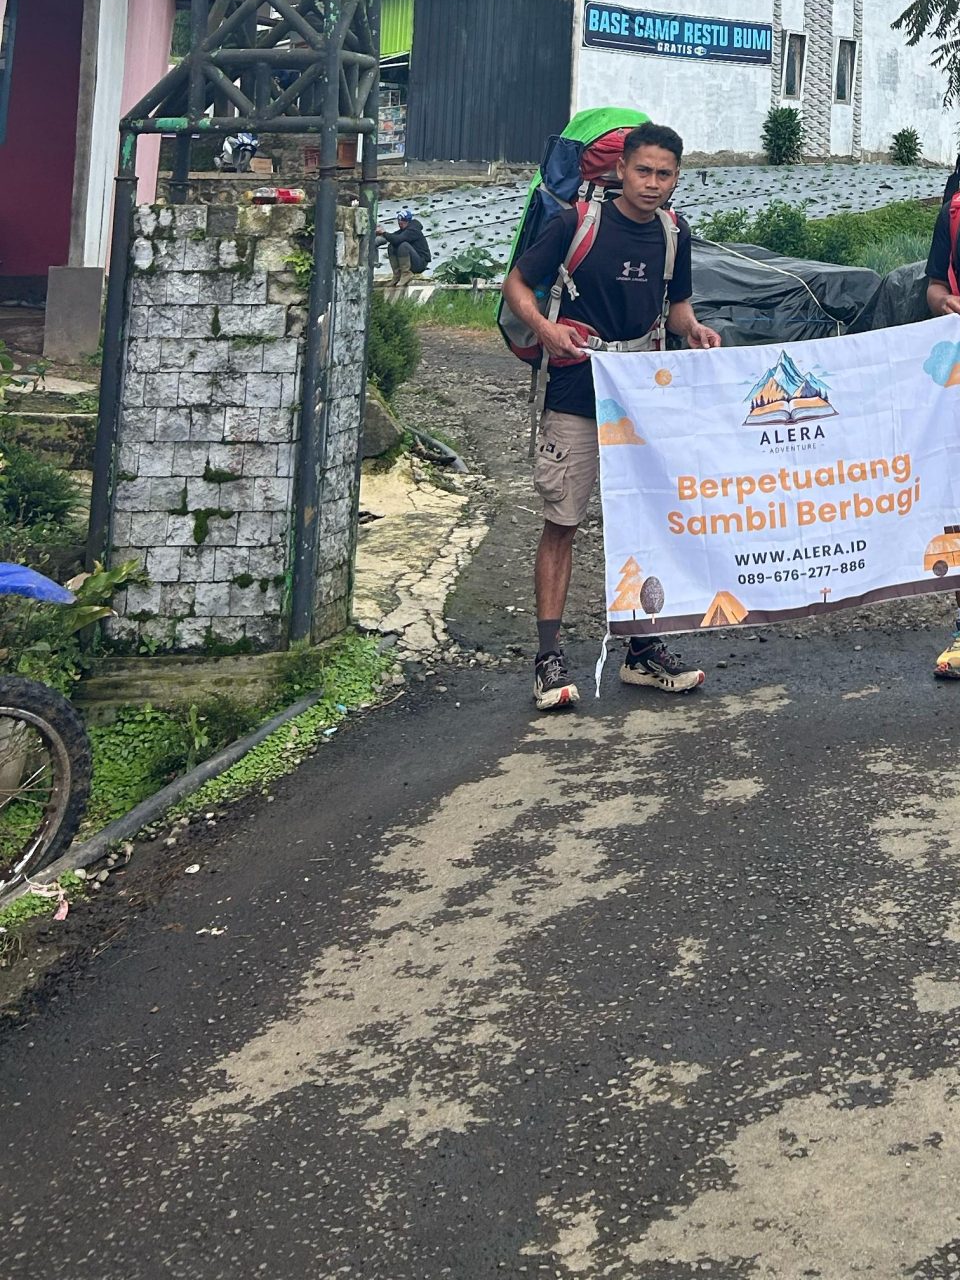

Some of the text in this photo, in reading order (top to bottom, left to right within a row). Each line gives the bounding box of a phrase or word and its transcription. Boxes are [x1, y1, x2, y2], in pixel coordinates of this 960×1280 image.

[589, 8, 771, 51] BASE CAMP RESTU BUMI
[657, 42, 693, 55] GRATIS
[760, 425, 825, 445] ALERA
[769, 443, 816, 454] ADVENTURE
[678, 452, 912, 504] Berpetualang
[668, 477, 921, 536] Sambil Berbagi
[735, 539, 867, 566] WWW.ALERA.ID
[738, 559, 865, 585] 089-676-277-886
